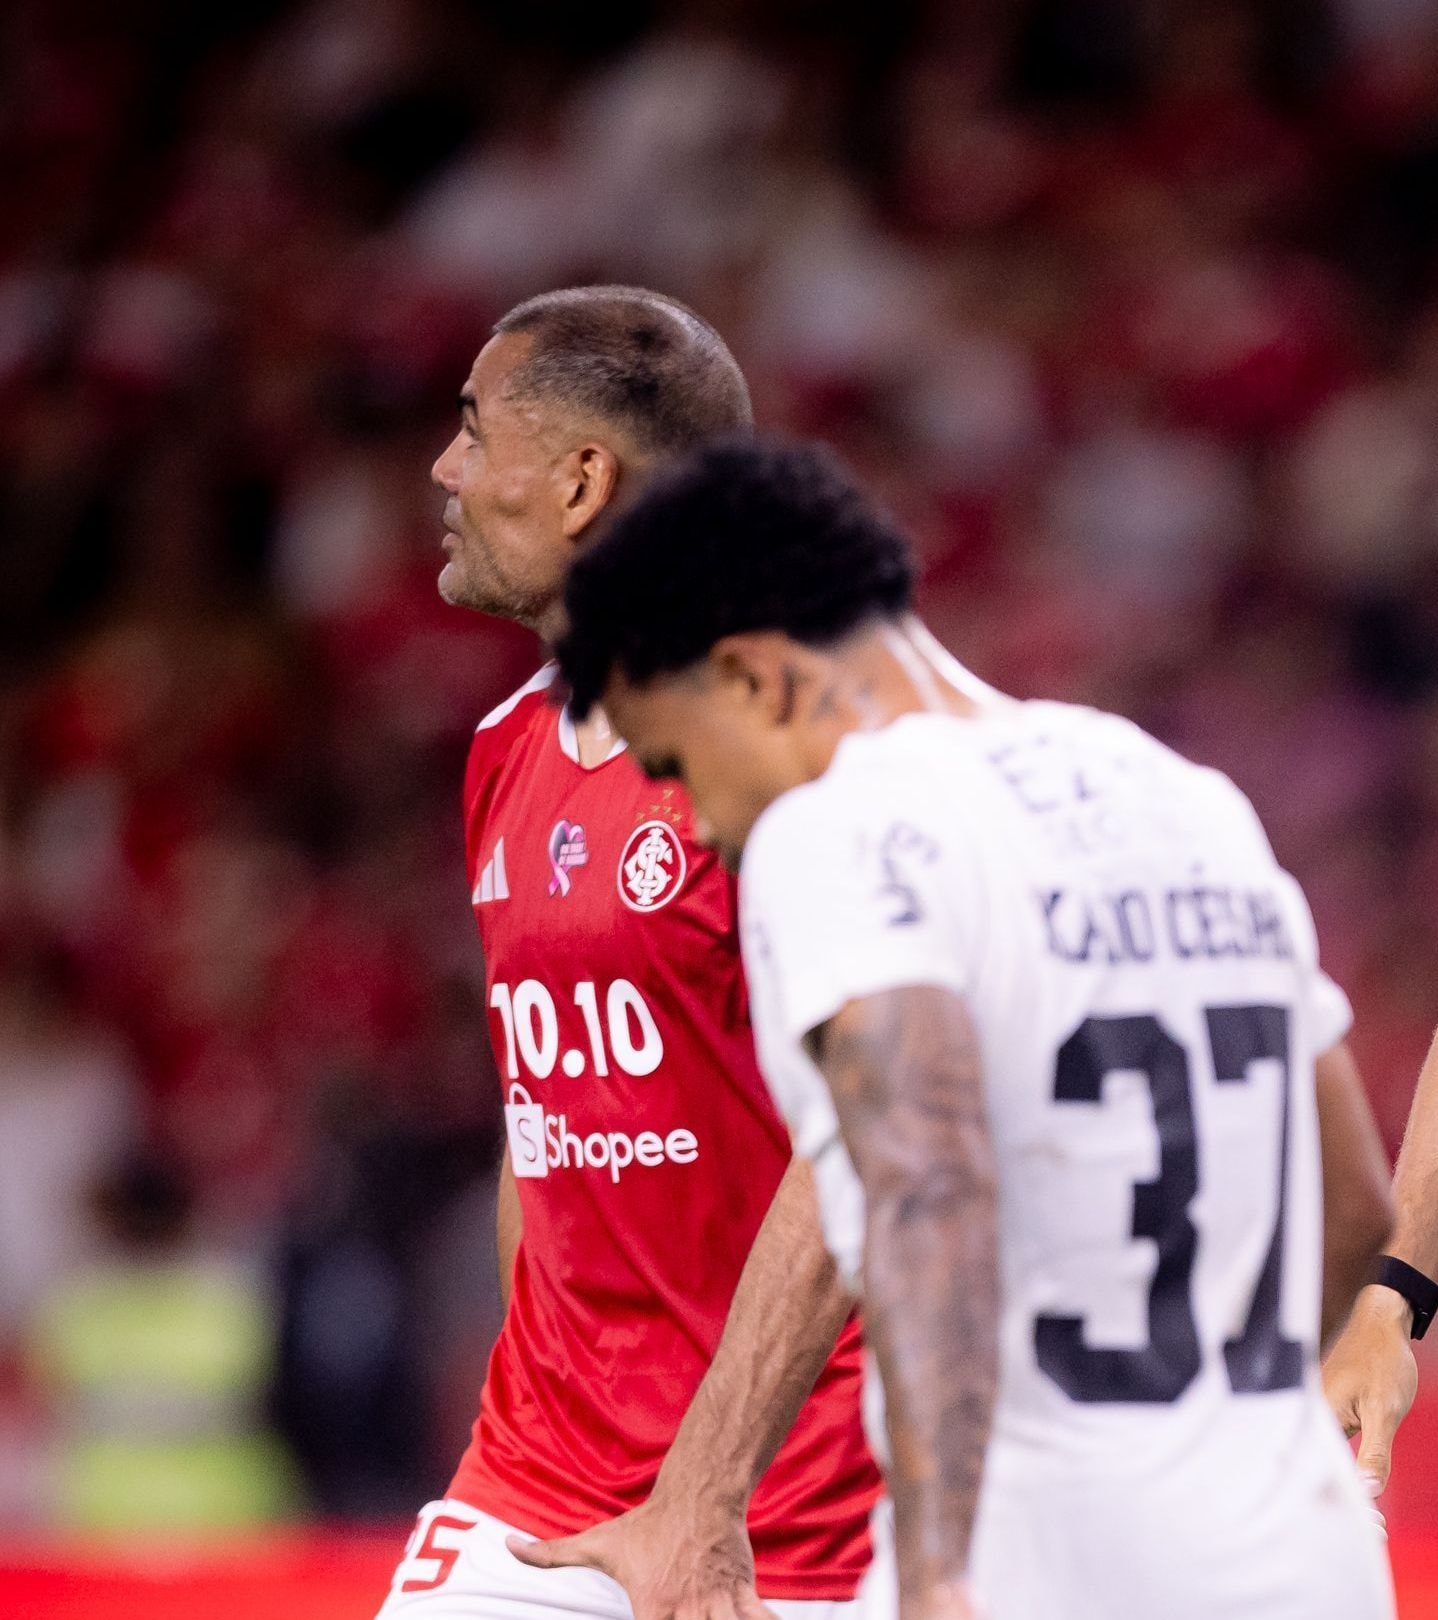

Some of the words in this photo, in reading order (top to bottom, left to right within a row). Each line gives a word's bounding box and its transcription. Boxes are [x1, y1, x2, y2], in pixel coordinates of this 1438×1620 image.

[490, 978, 663, 1079] 10.10
[544, 1114, 699, 1183] Shopee
[1034, 1006, 1304, 1402] 37
[402, 1515, 478, 1592] 5
